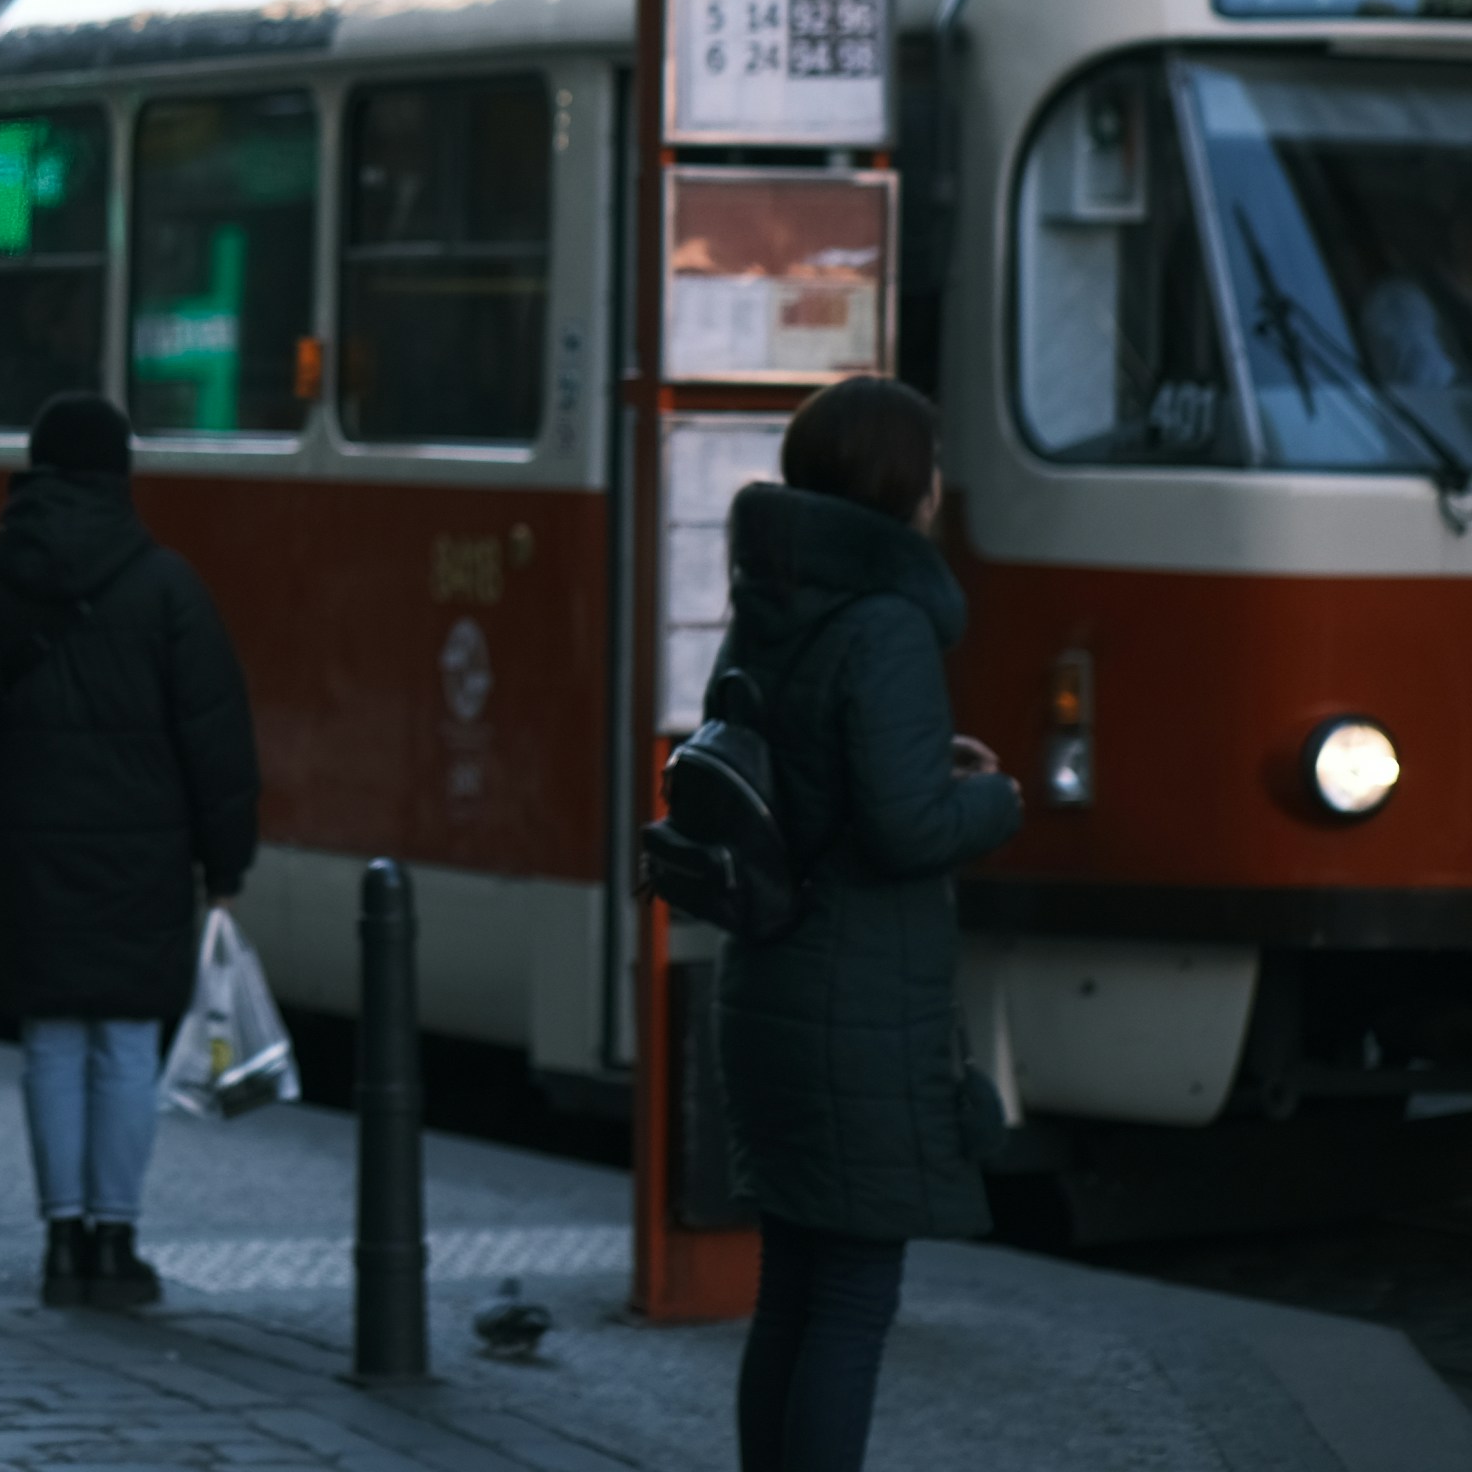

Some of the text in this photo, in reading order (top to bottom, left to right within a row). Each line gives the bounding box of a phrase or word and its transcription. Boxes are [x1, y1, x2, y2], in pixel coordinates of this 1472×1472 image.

[747, 0, 780, 31] 14
[705, 41, 780, 74] 6 24
